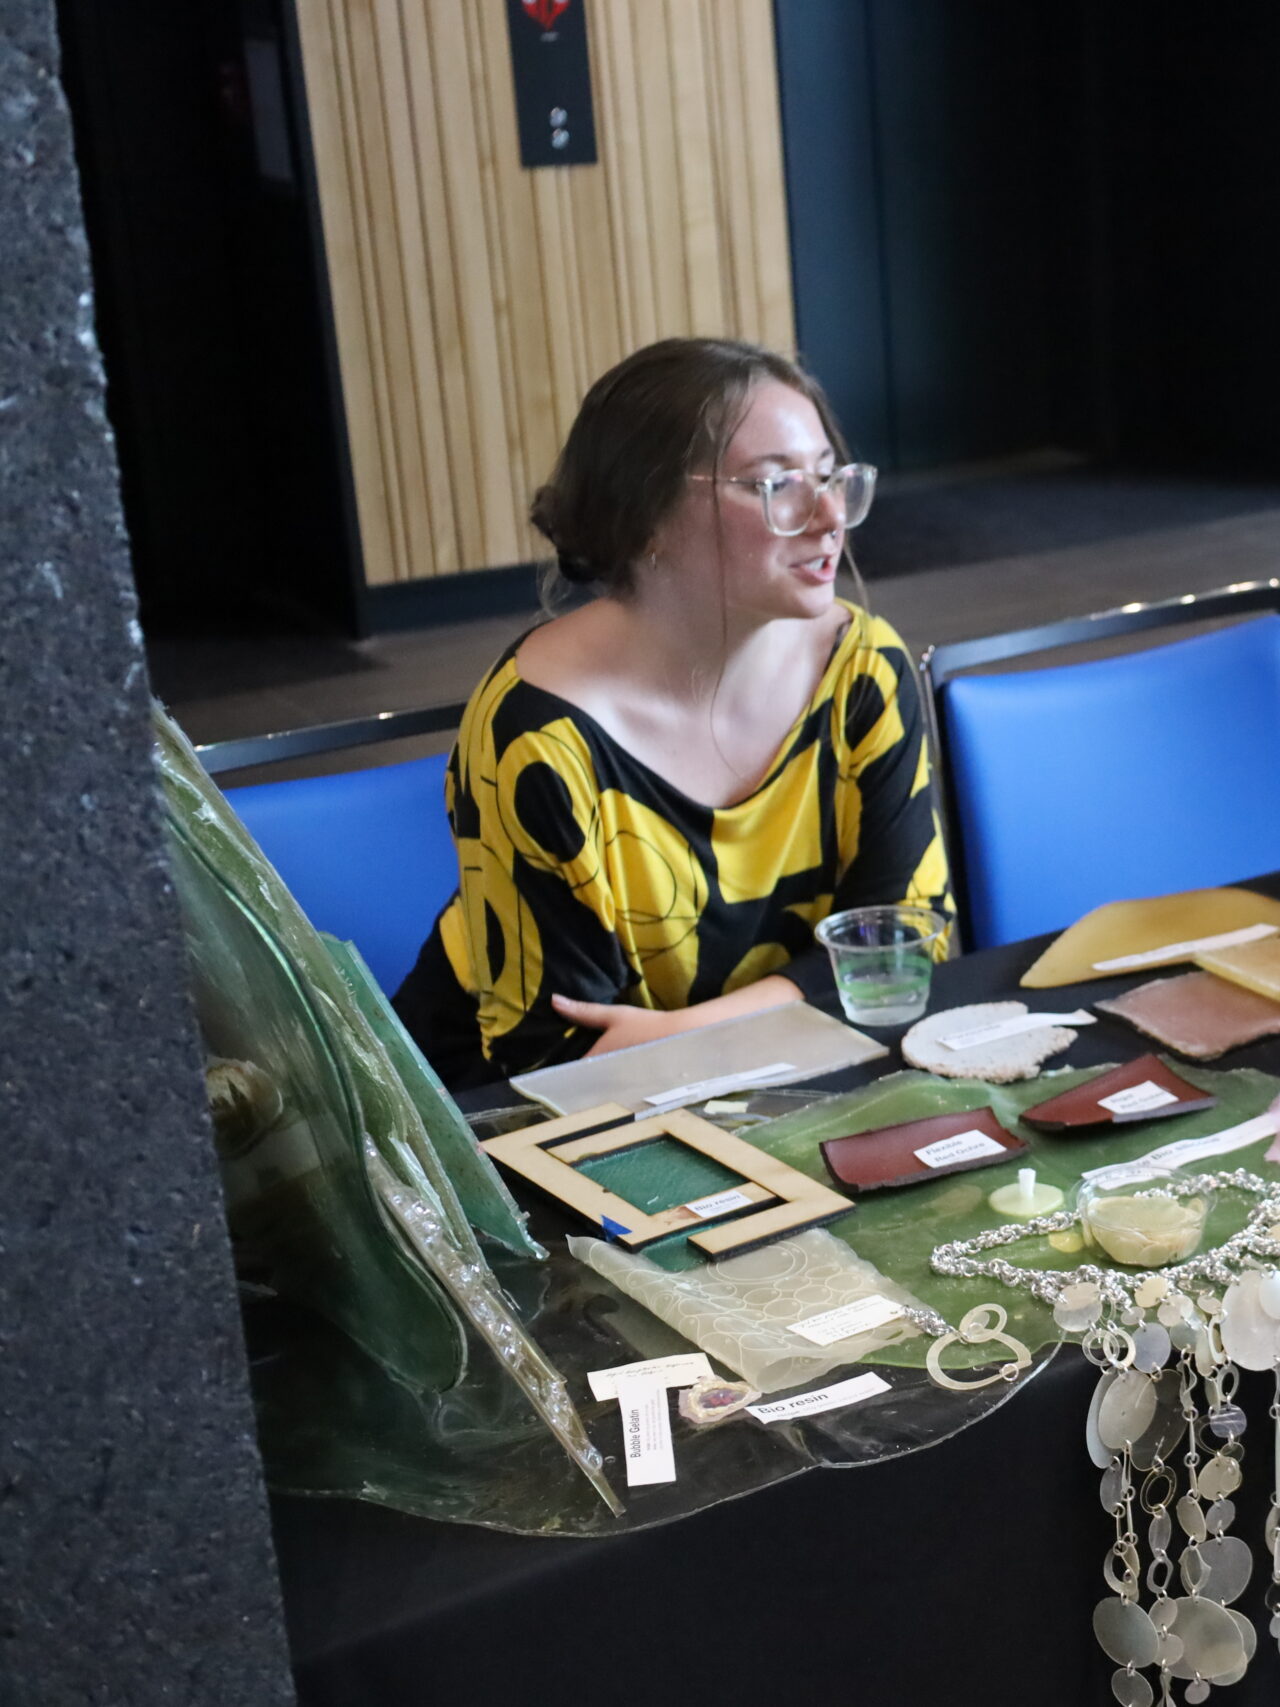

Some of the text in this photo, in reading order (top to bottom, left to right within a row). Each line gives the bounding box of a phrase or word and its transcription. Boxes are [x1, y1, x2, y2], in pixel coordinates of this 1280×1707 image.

[758, 1393, 829, 1414] Bio resin
[629, 1409, 641, 1458] Bubble Gelatin
